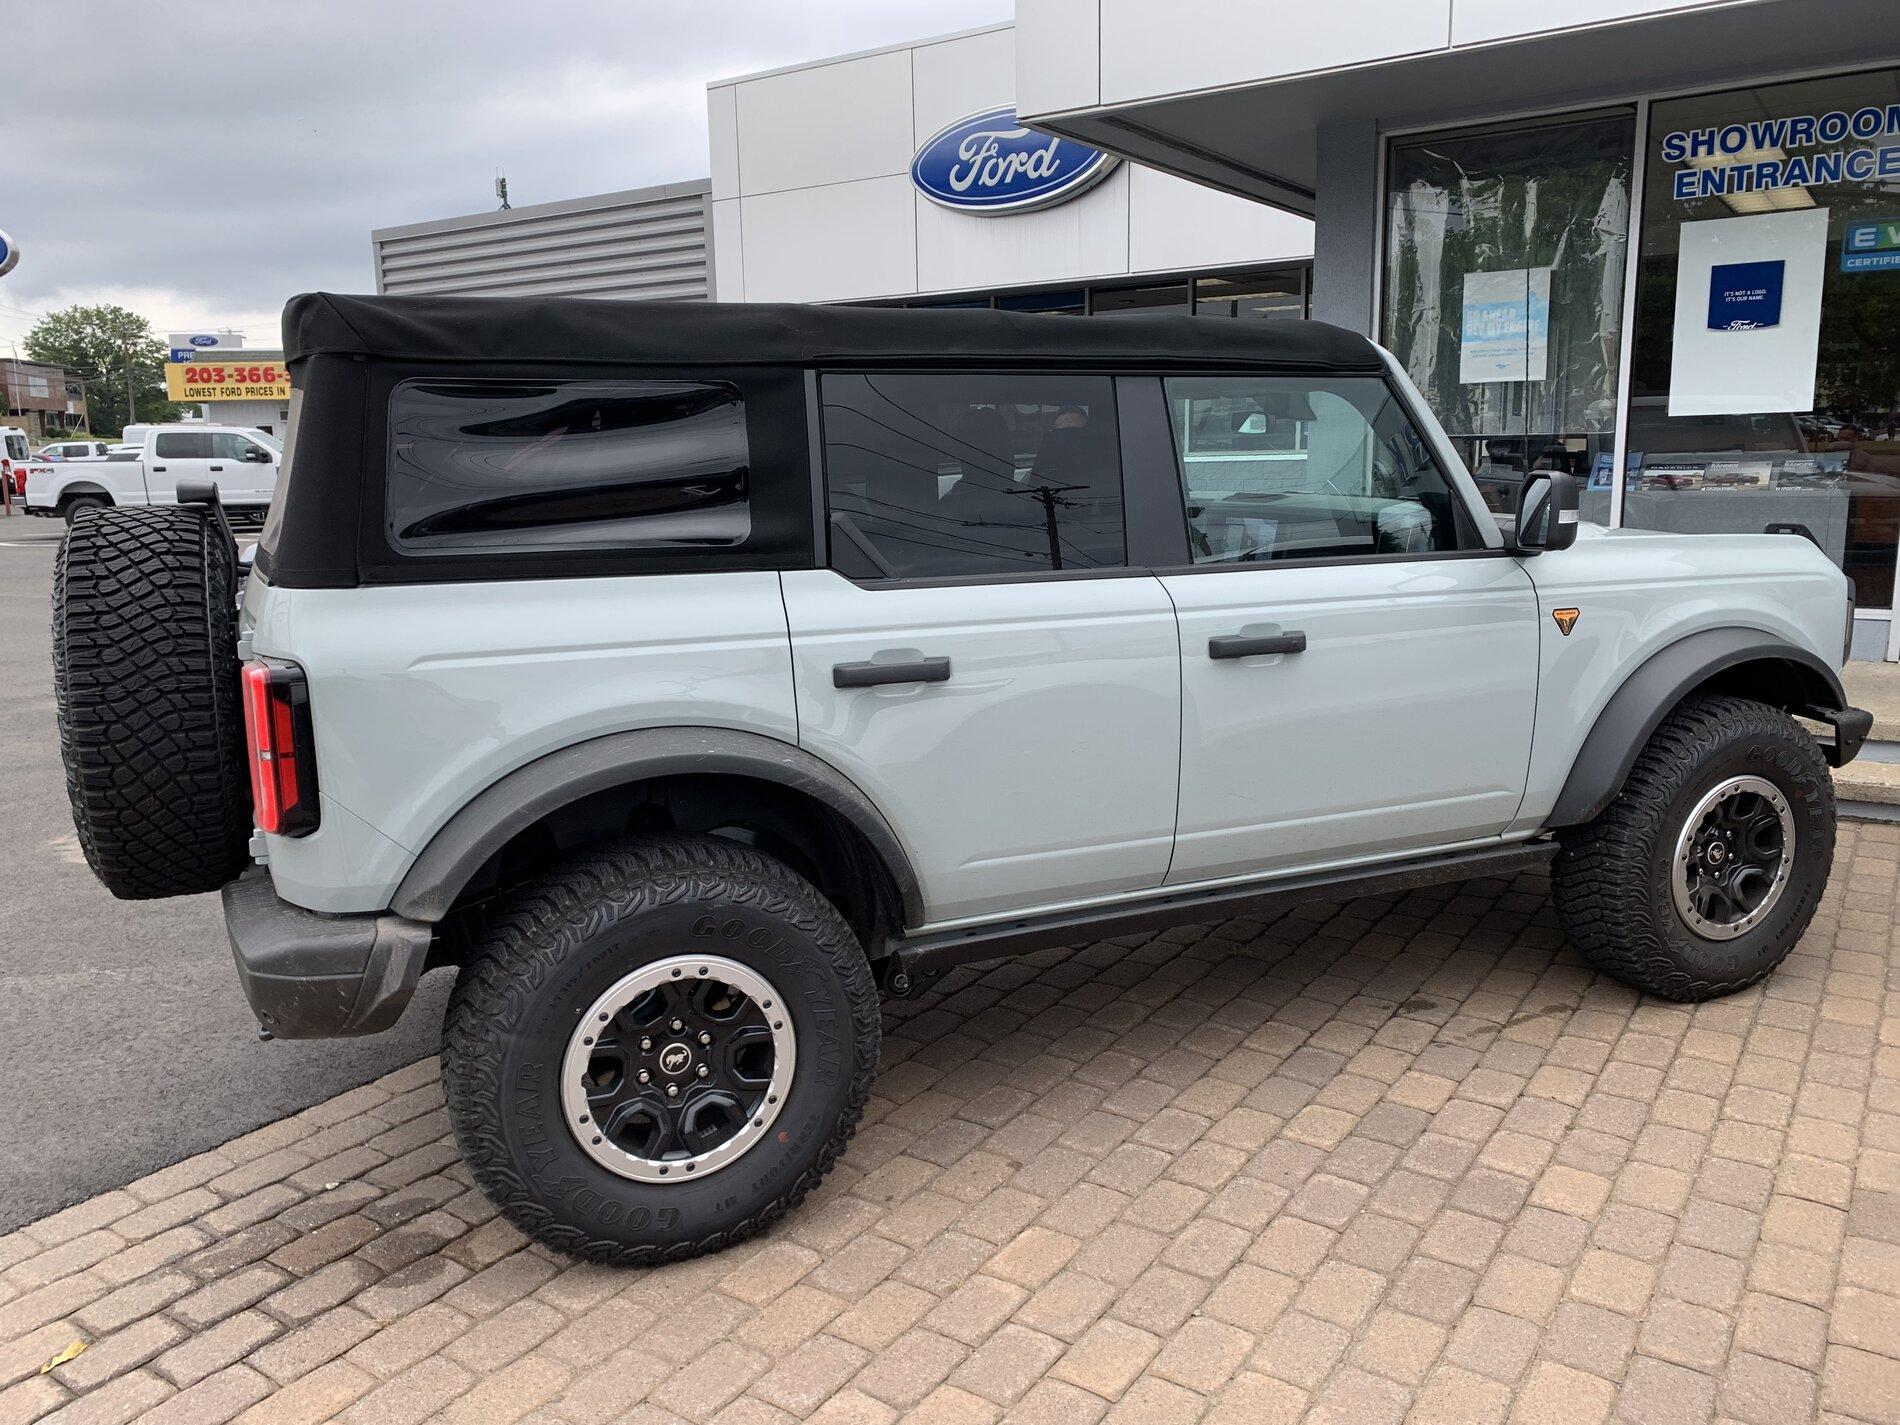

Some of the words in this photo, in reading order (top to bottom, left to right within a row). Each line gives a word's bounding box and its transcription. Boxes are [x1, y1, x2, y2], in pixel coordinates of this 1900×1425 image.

[949, 127, 1061, 192] Ford
[1673, 145, 1900, 200] ENTRANCE
[1727, 319, 1757, 331] Ford
[184, 387, 217, 397] LOWEST
[220, 387, 242, 397] FORD
[245, 386, 274, 396] PRICES
[277, 386, 286, 396] IN
[691, 914, 842, 1087] GOODYEAR
[515, 1062, 681, 1231] GOODYEAR
